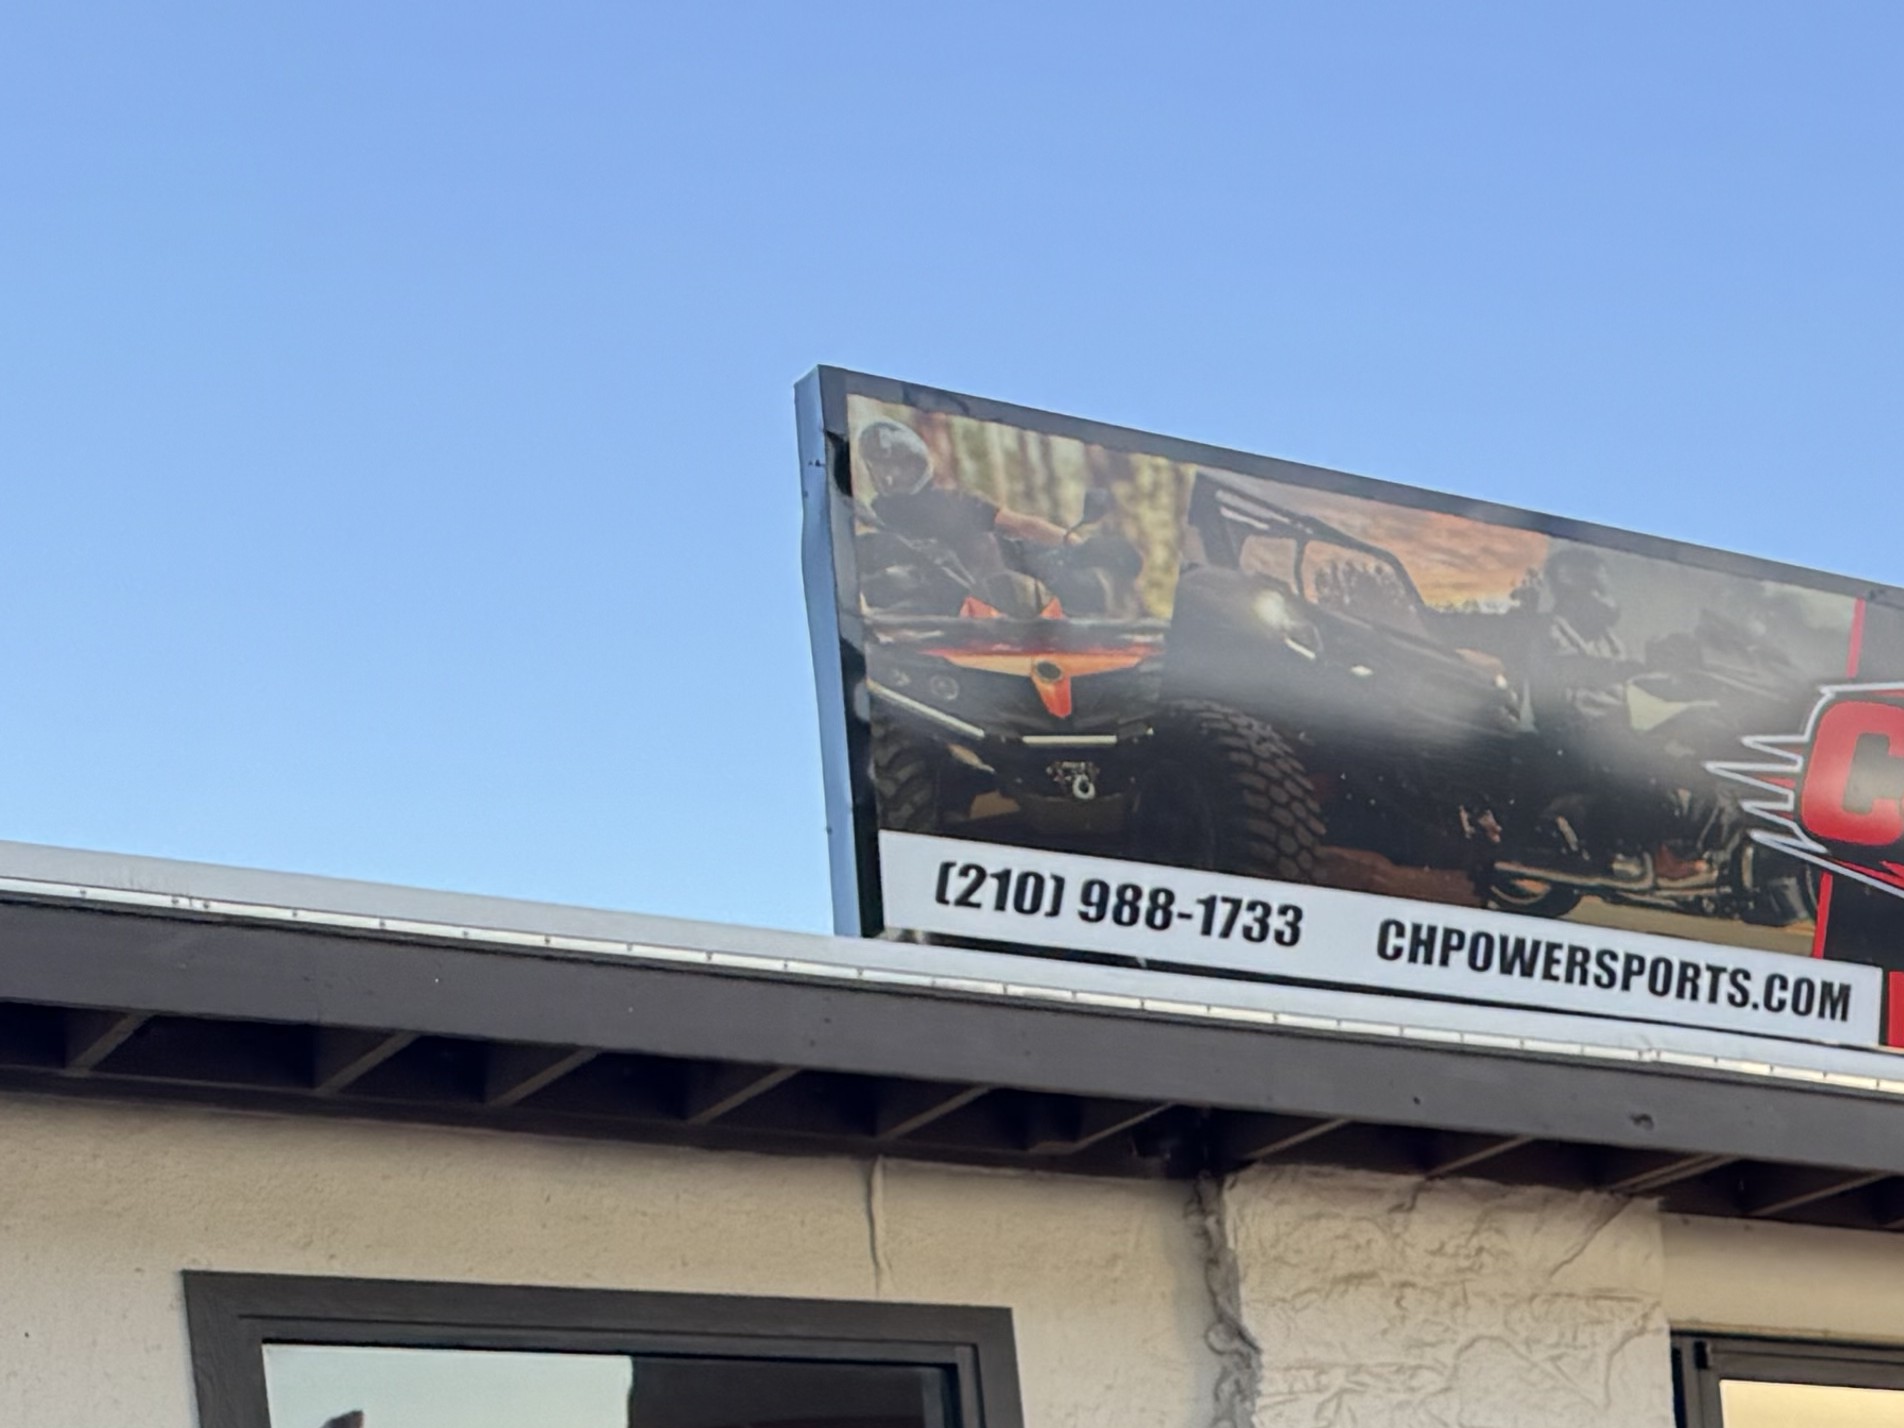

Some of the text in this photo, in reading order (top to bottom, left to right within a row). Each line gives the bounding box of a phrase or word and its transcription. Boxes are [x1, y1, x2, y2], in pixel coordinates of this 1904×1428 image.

[935, 861, 1303, 948] (210) 988-1733
[1376, 918, 1852, 1023] CHPOWERSPORTS.COM
